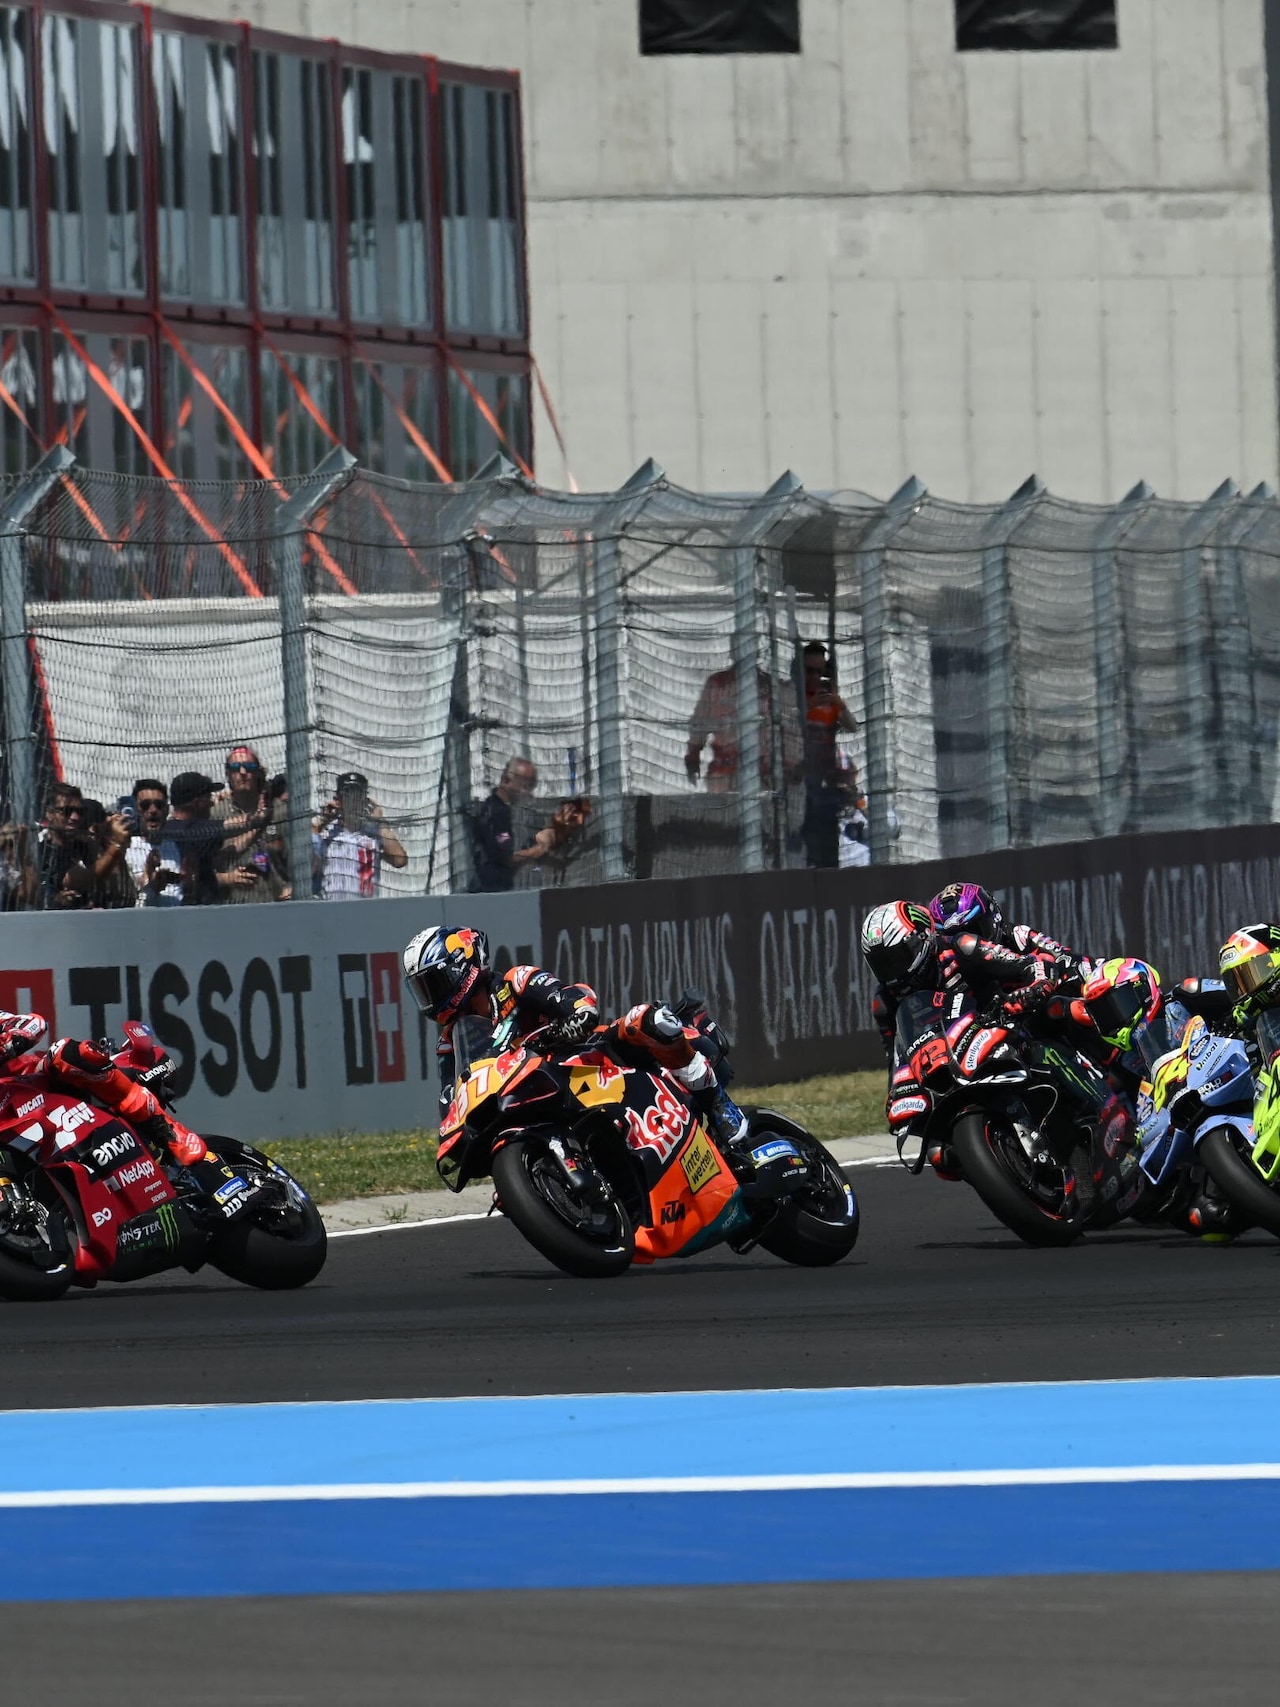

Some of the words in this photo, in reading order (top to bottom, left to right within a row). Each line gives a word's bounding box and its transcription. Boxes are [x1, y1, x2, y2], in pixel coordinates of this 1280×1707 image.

[760, 907, 839, 1060] QATAR
[966, 1031, 989, 1069] sterilgarda
[138, 1064, 167, 1083] Lenovo
[16, 1093, 45, 1118] DUCATI
[456, 1064, 494, 1120] 37
[891, 1100, 924, 1114] sterilgarda
[61, 1101, 96, 1132] GIVI
[625, 1072, 691, 1165] Red
[118, 1158, 155, 1188] NetApp
[660, 1200, 687, 1226] KTM
